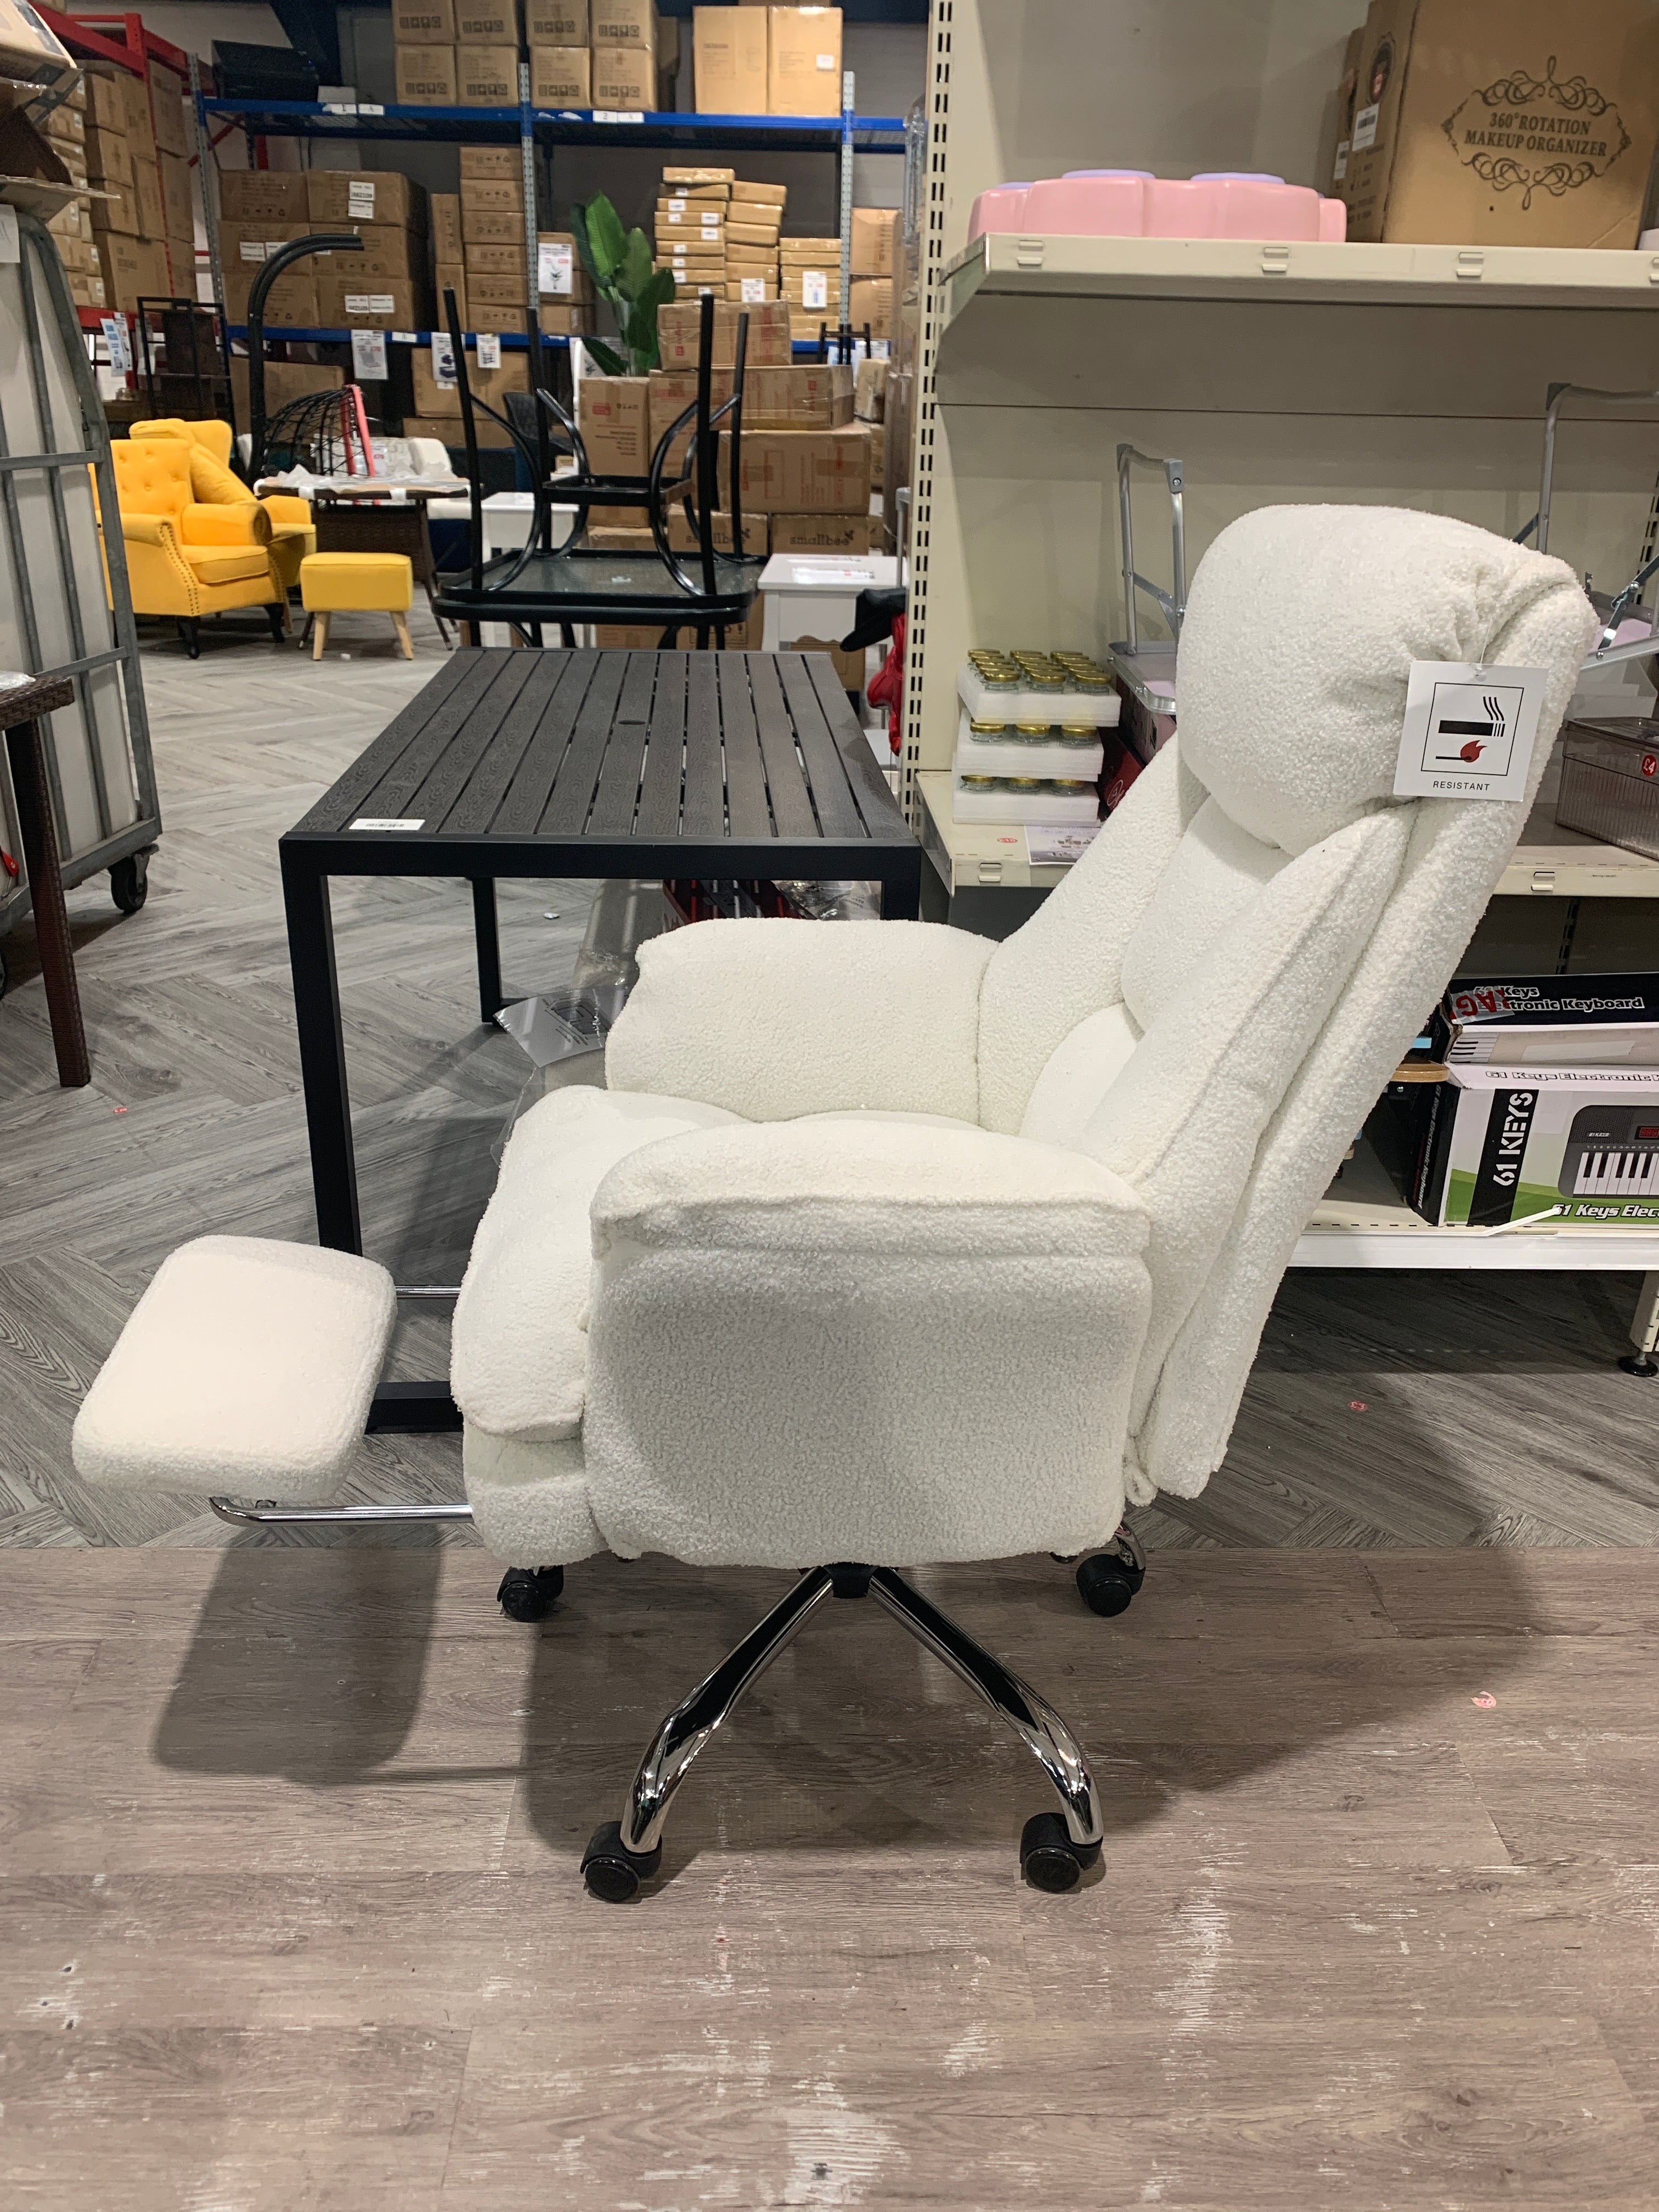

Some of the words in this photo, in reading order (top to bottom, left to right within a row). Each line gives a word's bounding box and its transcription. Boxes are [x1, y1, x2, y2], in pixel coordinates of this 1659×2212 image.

[1464, 129, 1525, 149] MAKEUP
[1526, 136, 1607, 156] ORGANIZER
[790, 533, 850, 545] smallbee
[1643, 758, 1656, 774] £4
[1433, 781, 1490, 791] RESISTANT
[1499, 986, 1540, 999] Keys
[1475, 999, 1560, 1011] Eetronic
[1561, 997, 1645, 1013] Keyboard
[1512, 1072, 1558, 1081] Keys
[1559, 1073, 1651, 1081] Electronic
[1499, 1092, 1533, 1155] KEYS
[1425, 1120, 1436, 1166] Electronic
[1493, 1164, 1518, 1186] 61
[1418, 1165, 1429, 1209] Keyboard
[1575, 1204, 1621, 1220] Keys
[1620, 1204, 1659, 1217] Elec
